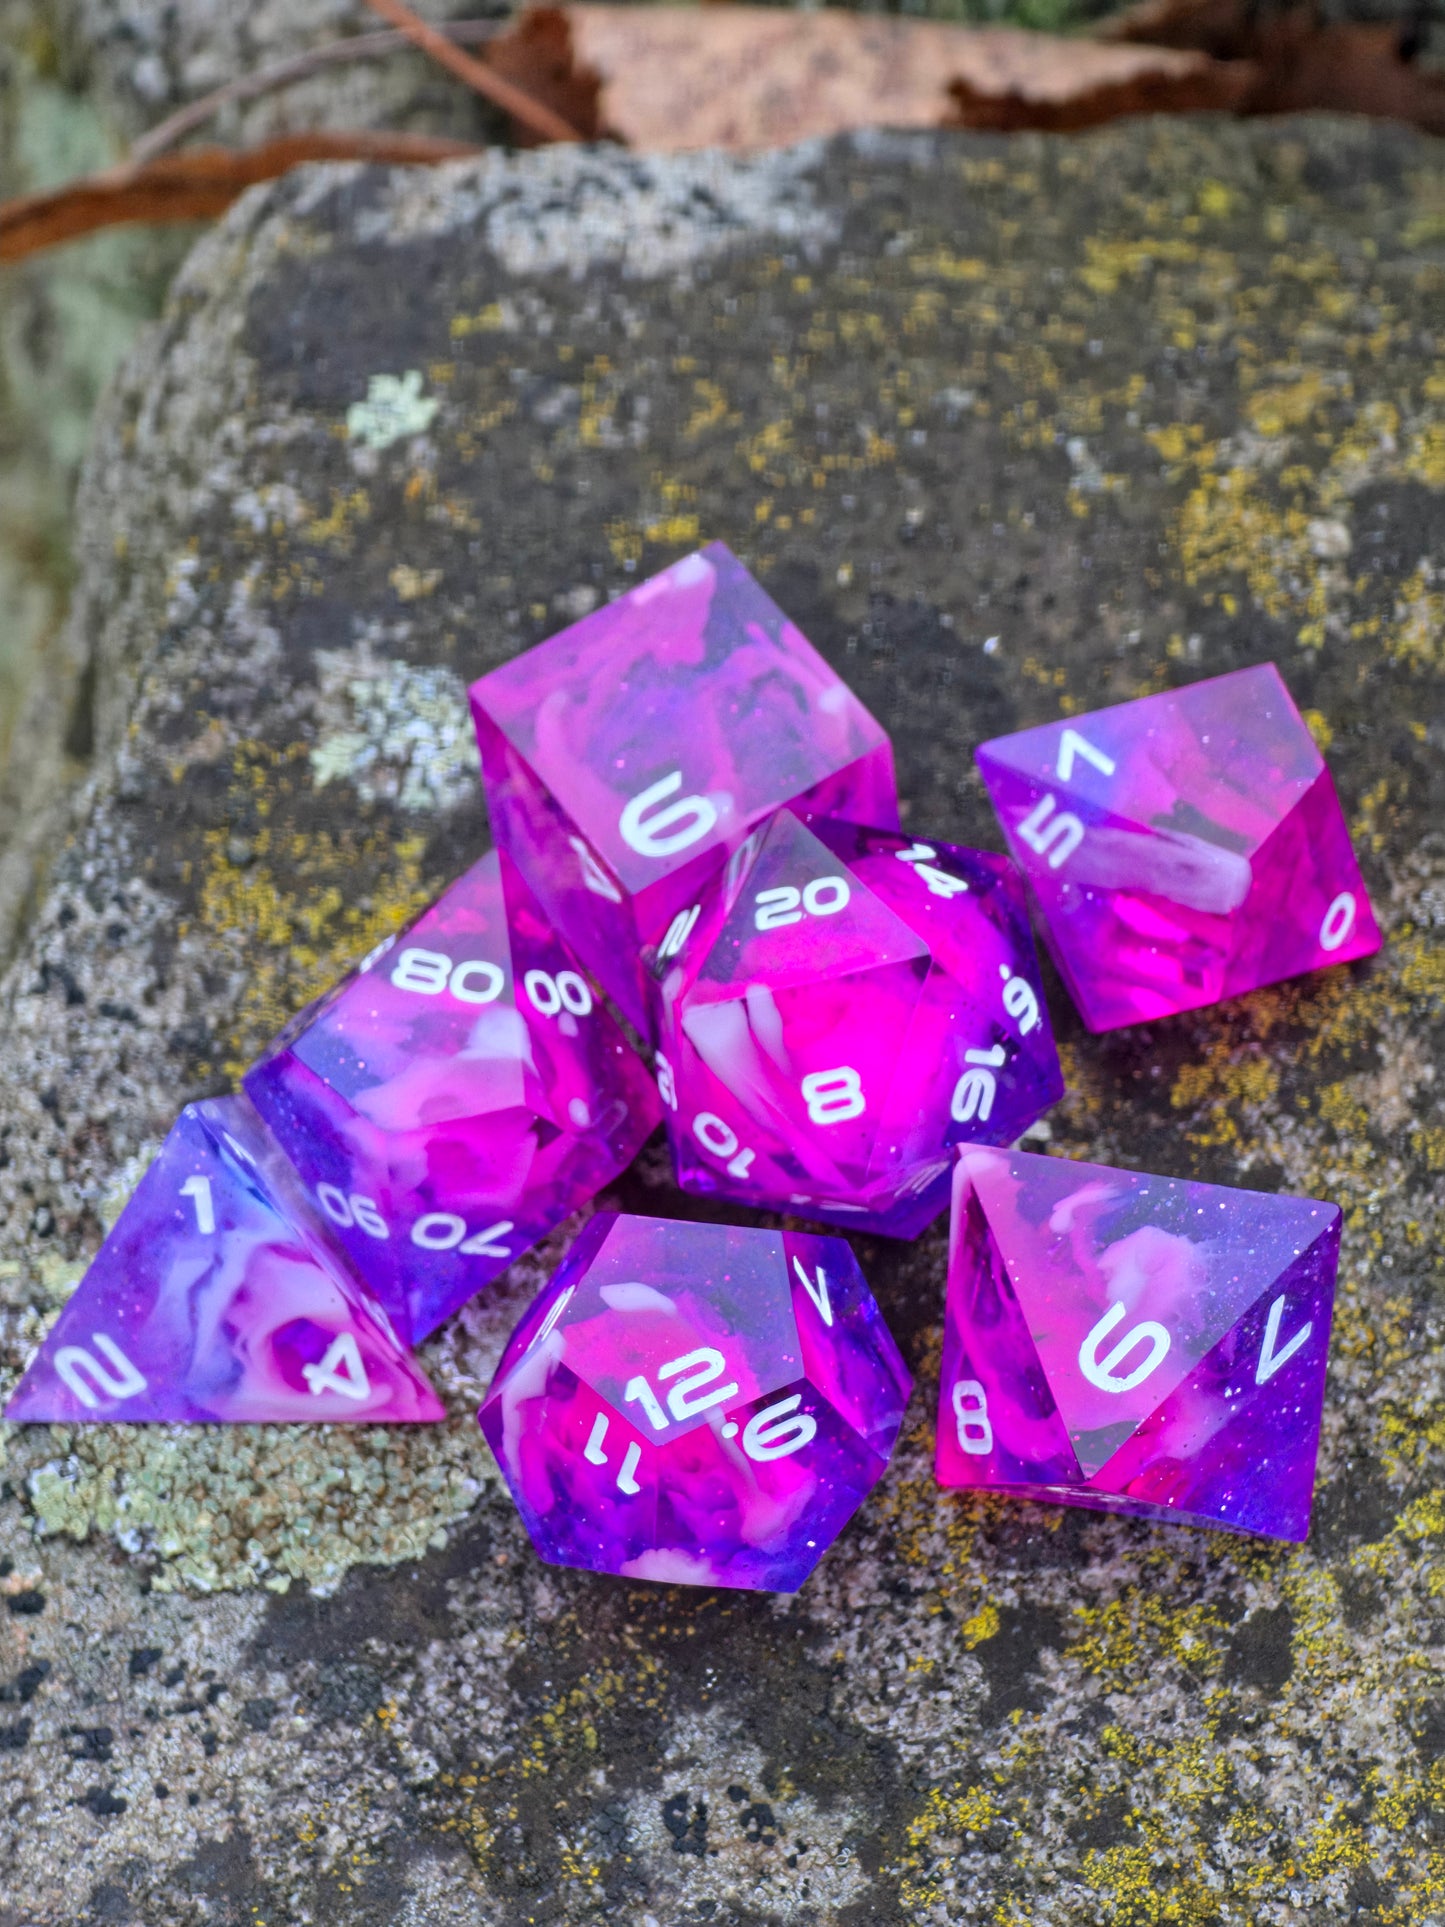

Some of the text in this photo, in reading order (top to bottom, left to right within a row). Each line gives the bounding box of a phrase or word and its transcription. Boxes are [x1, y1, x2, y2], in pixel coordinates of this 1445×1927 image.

[1056, 729, 1117, 783] 7
[619, 769, 718, 858] 6
[1017, 793, 1085, 869] 5
[755, 876, 851, 931] 20
[895, 843, 968, 899] 14
[1319, 891, 1357, 951] 0
[390, 948, 505, 1004] 80
[524, 969, 593, 1016] 00
[802, 1066, 866, 1125] 8
[950, 1044, 1006, 1123] 16
[692, 1112, 756, 1179] 10
[179, 1175, 216, 1235] 1
[411, 1212, 514, 1258] 70
[54, 1332, 148, 1408] 2
[302, 1331, 371, 1401] 4
[1078, 1301, 1171, 1393] 6
[1255, 1294, 1313, 1385] 7
[625, 1347, 739, 1431] 12
[952, 1380, 994, 1456] 8
